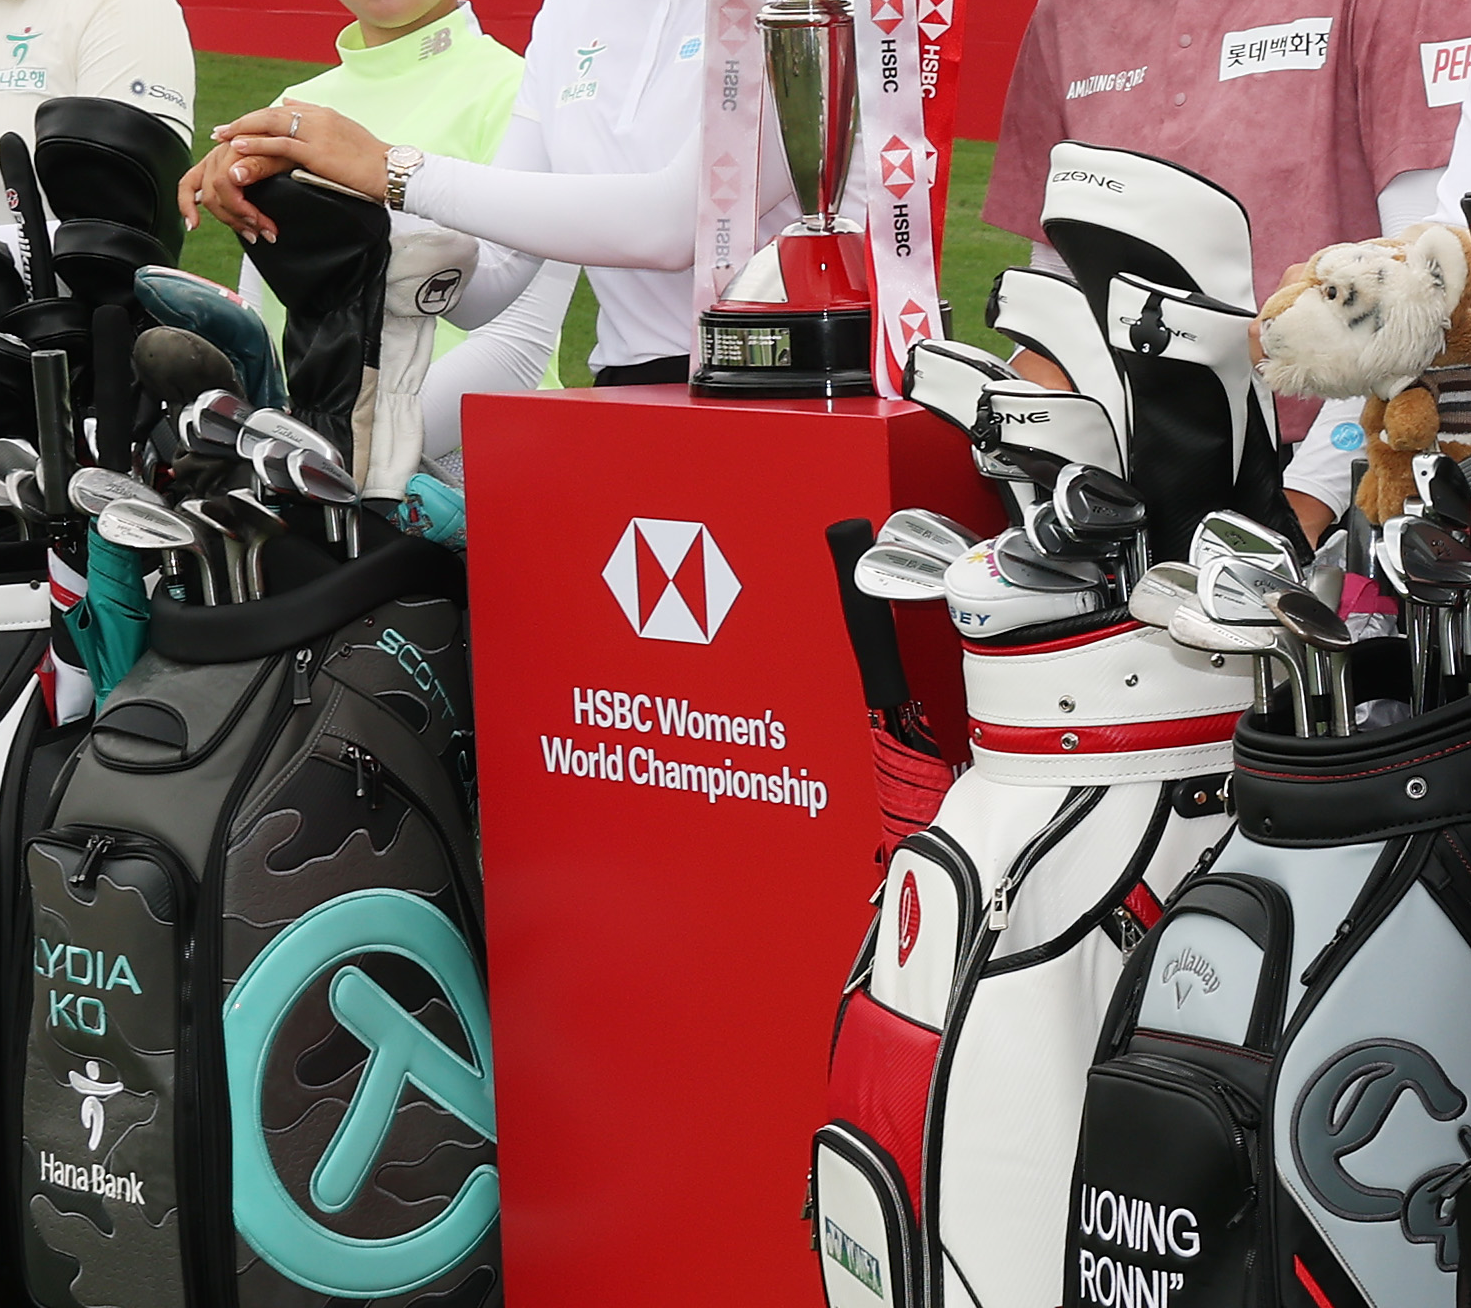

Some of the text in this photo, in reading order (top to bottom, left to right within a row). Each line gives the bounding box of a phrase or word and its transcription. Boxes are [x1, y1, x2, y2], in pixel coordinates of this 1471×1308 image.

[881, 39, 899, 94] HSBC
[921, 45, 941, 98] HSBC
[893, 204, 911, 258] HSBC
[377, 628, 456, 720] SCOTT
[573, 687, 786, 750] HSBC Women's
[541, 736, 828, 818] World Championship
[1162, 948, 1221, 994] Callaway
[49, 989, 106, 1036] KO
[40, 1151, 146, 1205] Hana Bank
[1079, 1184, 1201, 1259] UONING
